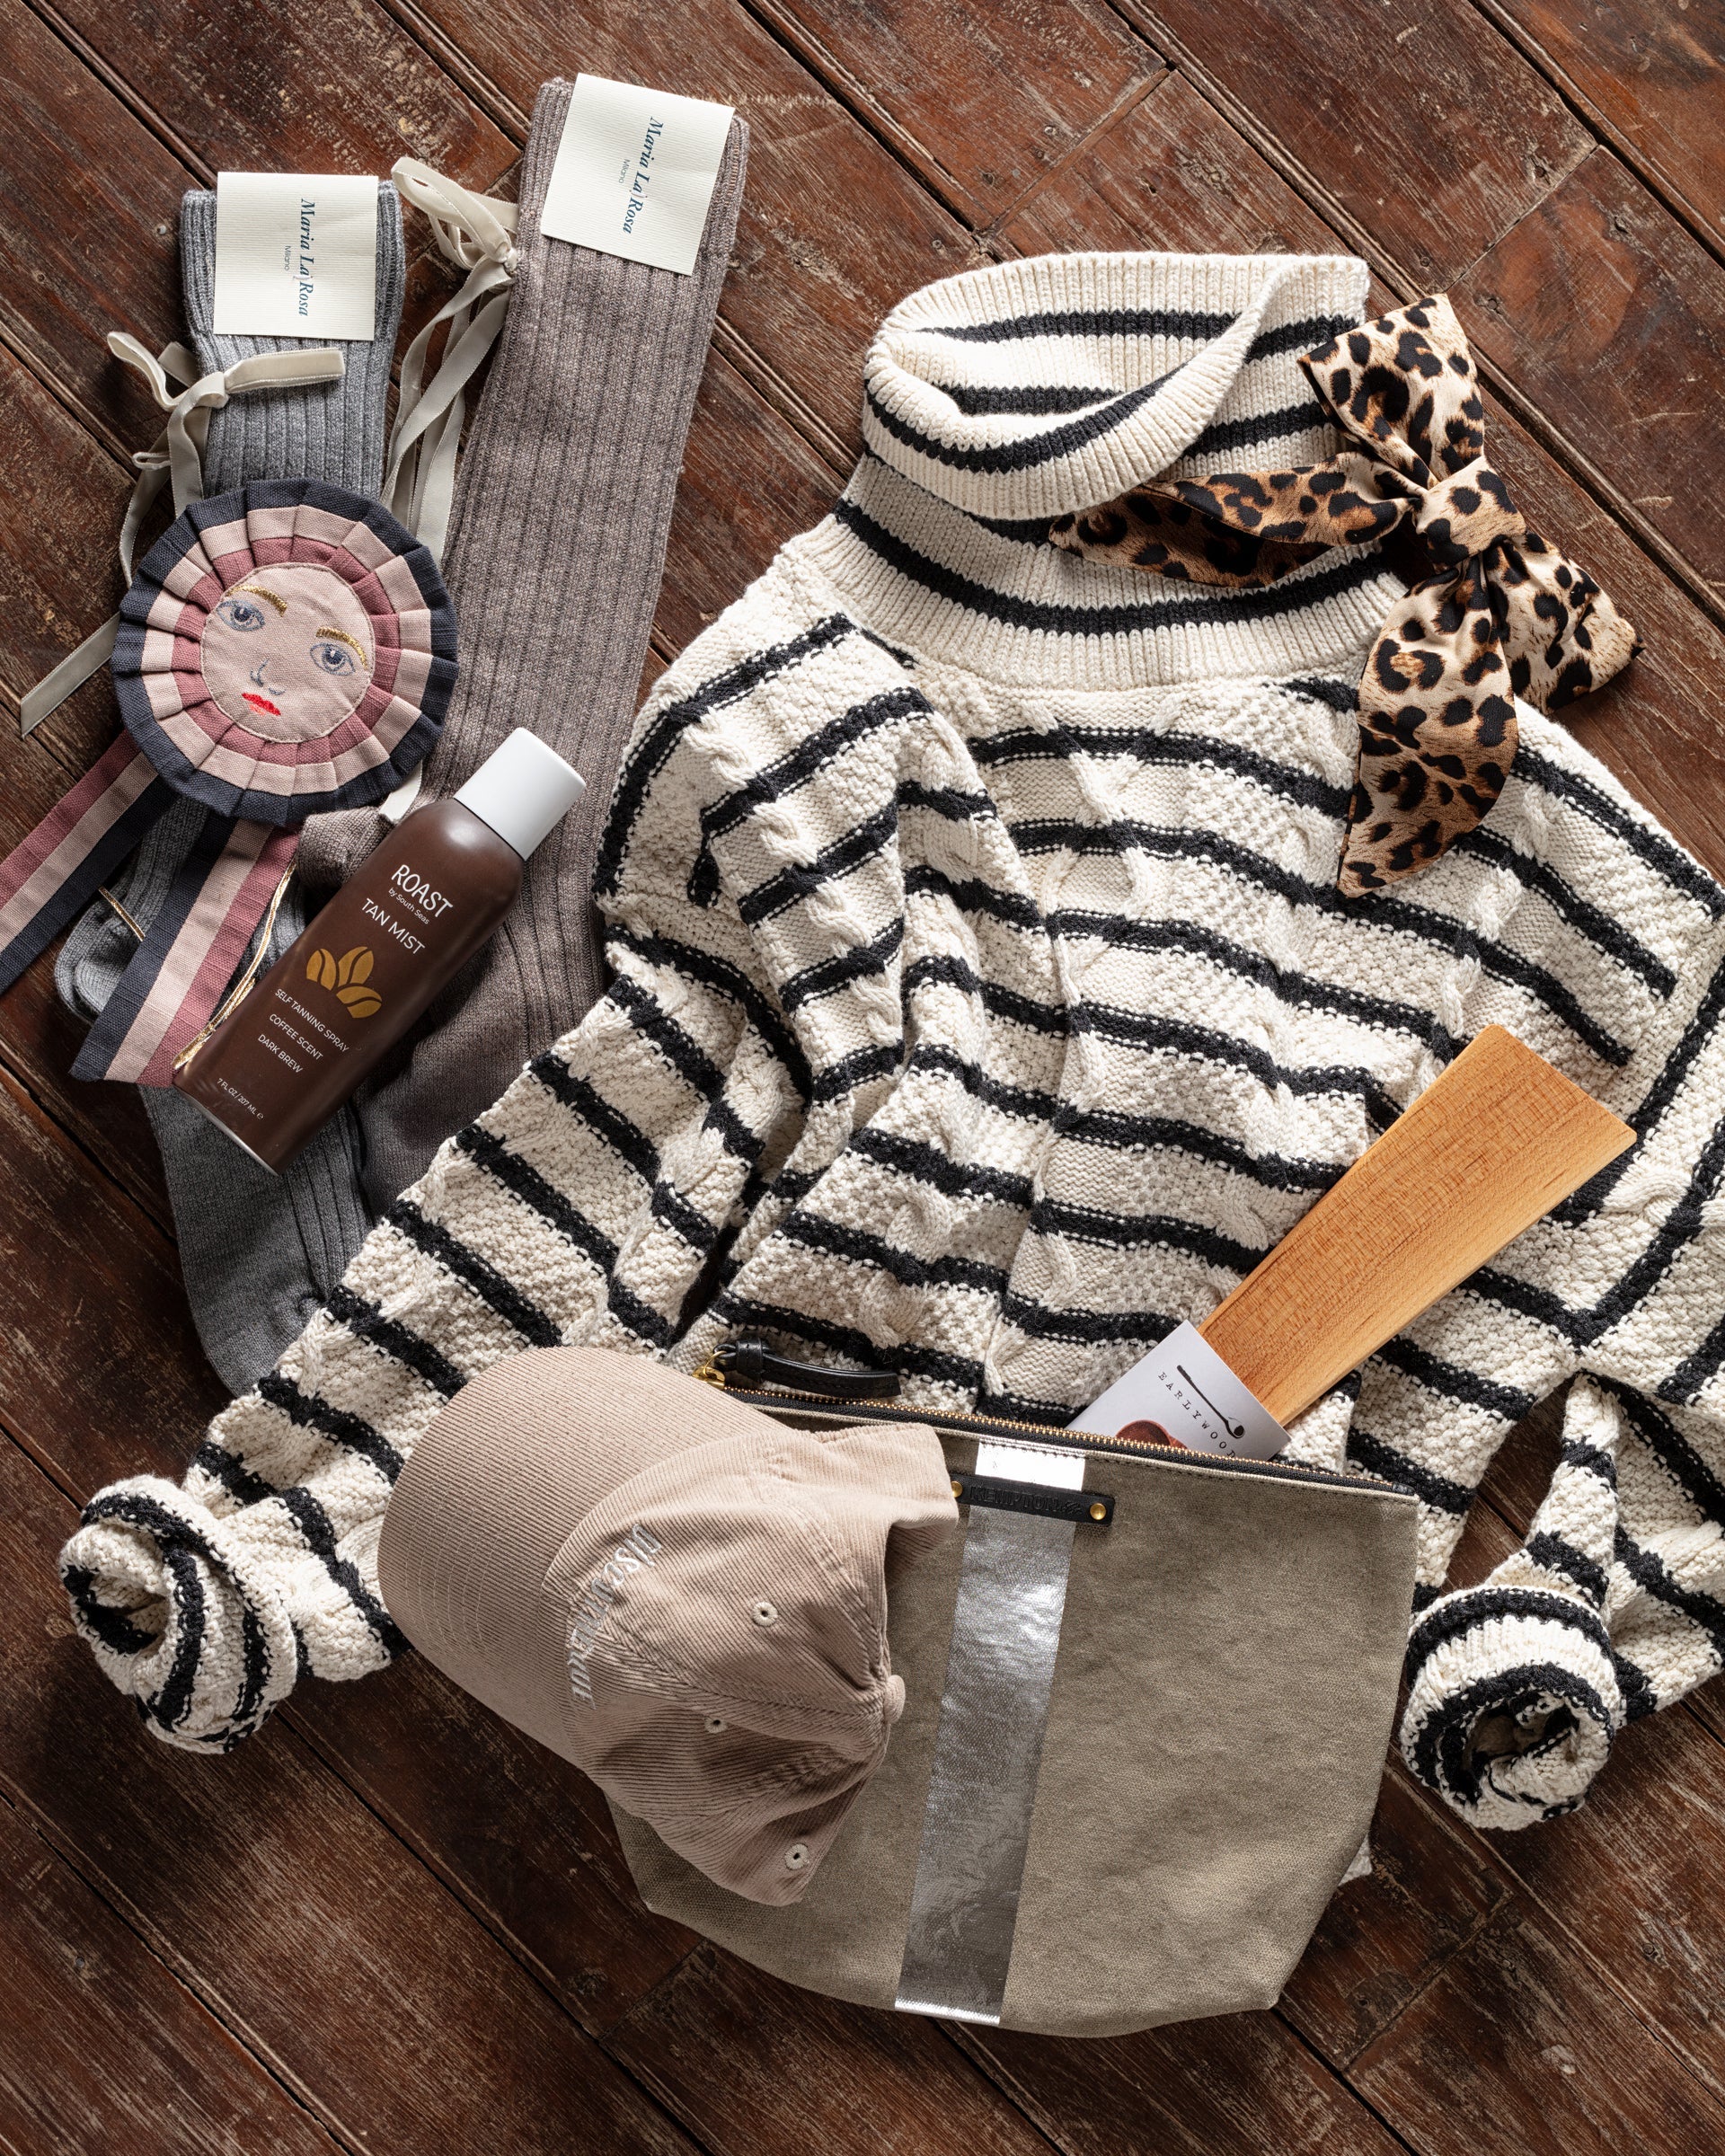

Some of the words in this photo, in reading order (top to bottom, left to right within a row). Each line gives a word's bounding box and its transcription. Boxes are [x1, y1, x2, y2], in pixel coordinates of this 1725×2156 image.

[639, 116, 664, 169] Maria
[618, 159, 631, 183] Milano
[632, 170, 650, 193] La
[300, 198, 315, 250] Maria
[623, 197, 643, 234] Rosa
[299, 254, 314, 276] La
[298, 282, 314, 316] Rosa
[388, 887, 398, 897] by
[395, 894, 415, 912] South
[414, 909, 429, 924] Seas
[391, 864, 454, 917] ROAST
[361, 897, 391, 926] TAN
[388, 921, 426, 954] MIST
[270, 1013, 299, 1040] COFFEE
[296, 1037, 323, 1060] SCENT
[275, 988, 293, 1003] SELF
[291, 1000, 325, 1032] TANNING
[323, 1029, 349, 1053] SPRAY
[258, 1034, 280, 1055] DARK
[278, 1050, 304, 1074] BREW
